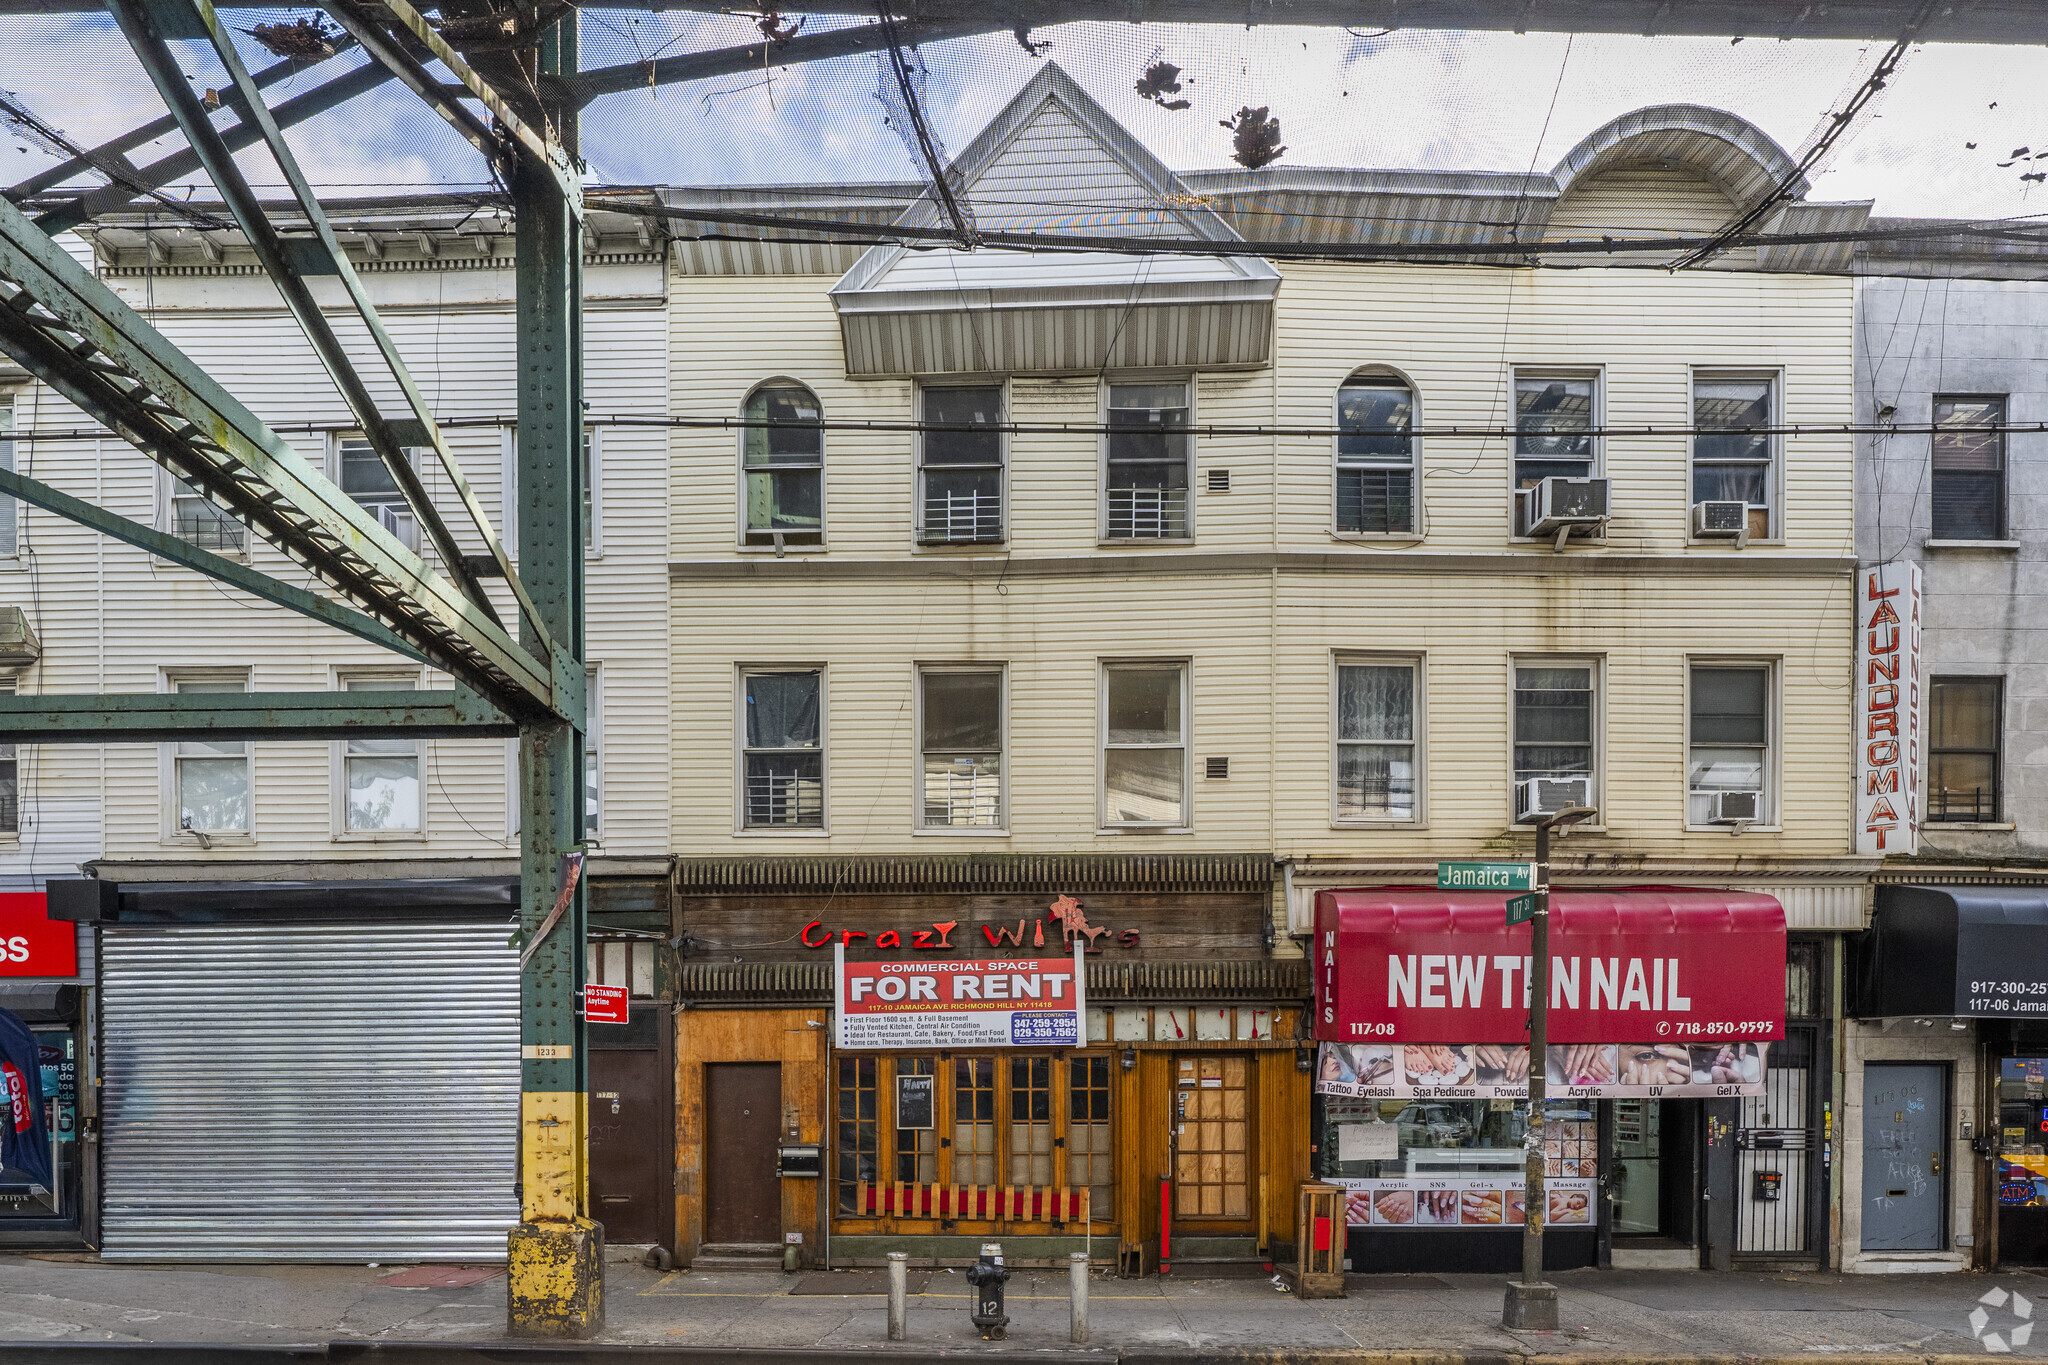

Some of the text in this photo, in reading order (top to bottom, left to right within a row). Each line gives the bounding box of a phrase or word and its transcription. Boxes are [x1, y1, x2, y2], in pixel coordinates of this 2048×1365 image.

[1866, 572, 1900, 850] LAUNDROMAT
[1909, 567, 1919, 849] LAUNDROMAT
[1442, 865, 1529, 886] Jamaica Av
[1513, 898, 1530, 921] 117 St
[880, 961, 1038, 974] COMMERCIAL SPACE
[1324, 930, 1335, 1024] NAILS
[1387, 954, 1487, 1009] NEW
[1590, 957, 1691, 1011] NAIL
[587, 988, 622, 998] NO STANDING
[850, 972, 1073, 1002] FOR RENT
[1970, 981, 2048, 995] 917-300-25
[588, 997, 610, 1006] Anytime
[1969, 998, 2010, 1011] 117-06
[1014, 1018, 1076, 1028] 347-259-2954
[1349, 1022, 1396, 1036] 117-08
[1675, 1021, 1774, 1035] 718-850-9595
[1014, 1027, 1077, 1037] 929-350-7562
[537, 1048, 556, 1056] 1233
[61, 1063, 74, 1071] 5G
[1327, 1082, 1352, 1095] Tattoo
[1357, 1086, 1395, 1097] Eyelash
[1412, 1087, 1431, 1098] Spa
[1434, 1086, 1476, 1096] Pedicure
[1494, 1087, 1529, 1096] Powde
[1568, 1086, 1602, 1098] Acrylic
[1649, 1086, 1663, 1096] UV
[1717, 1085, 1732, 1096] Gel
[1734, 1085, 1741, 1095] X
[1379, 1181, 1409, 1189] Acrylic
[1553, 1181, 1587, 1189] Massage
[2002, 1187, 2029, 1199] ATM
[982, 1301, 998, 1315] 12
